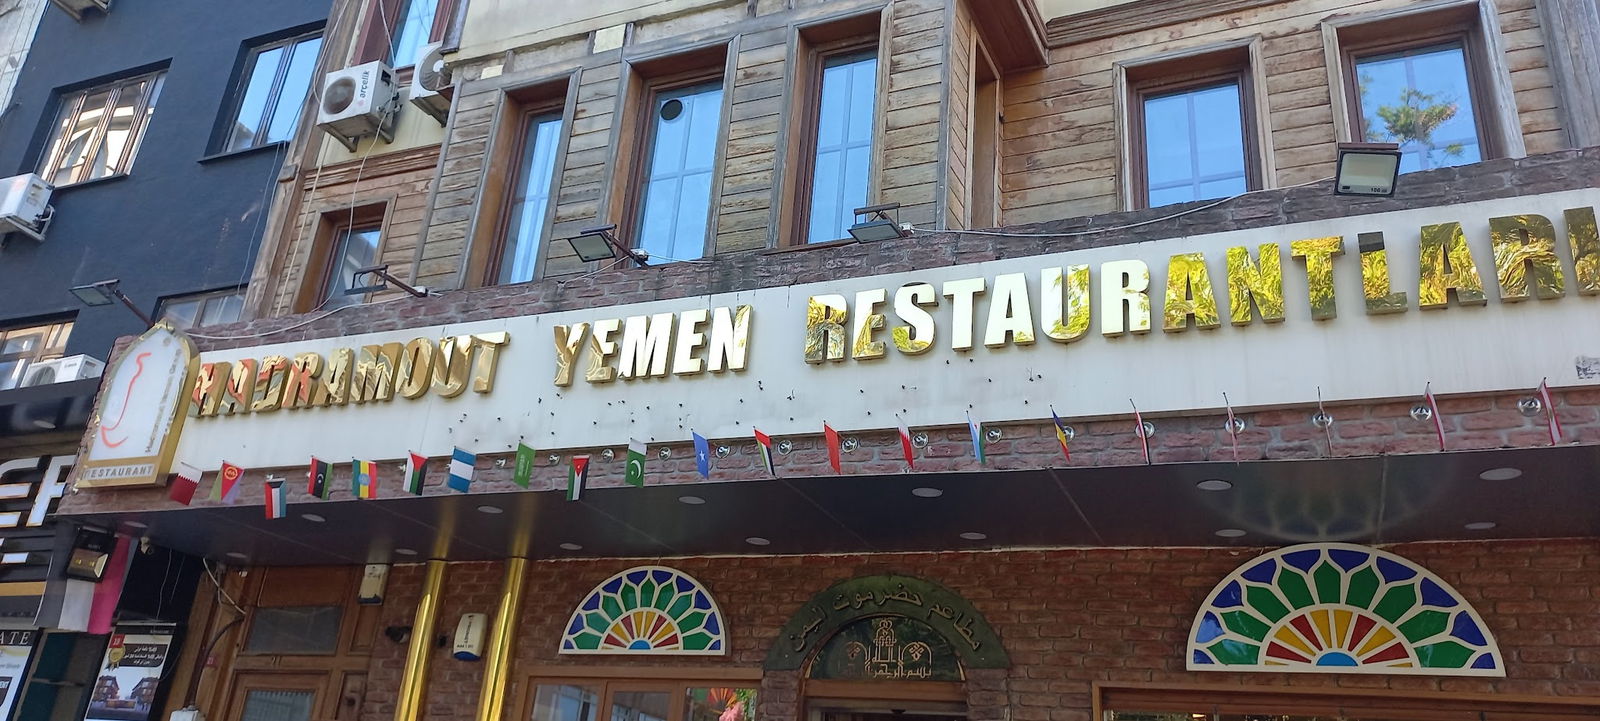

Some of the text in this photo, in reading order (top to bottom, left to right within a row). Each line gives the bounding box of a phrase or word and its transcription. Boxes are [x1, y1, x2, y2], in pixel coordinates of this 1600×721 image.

[190, 331, 510, 418] HADRAMOUT
[553, 305, 754, 387] YEMEN
[789, 605, 828, 653] اليمن
[927, 601, 984, 652] مطاعم
